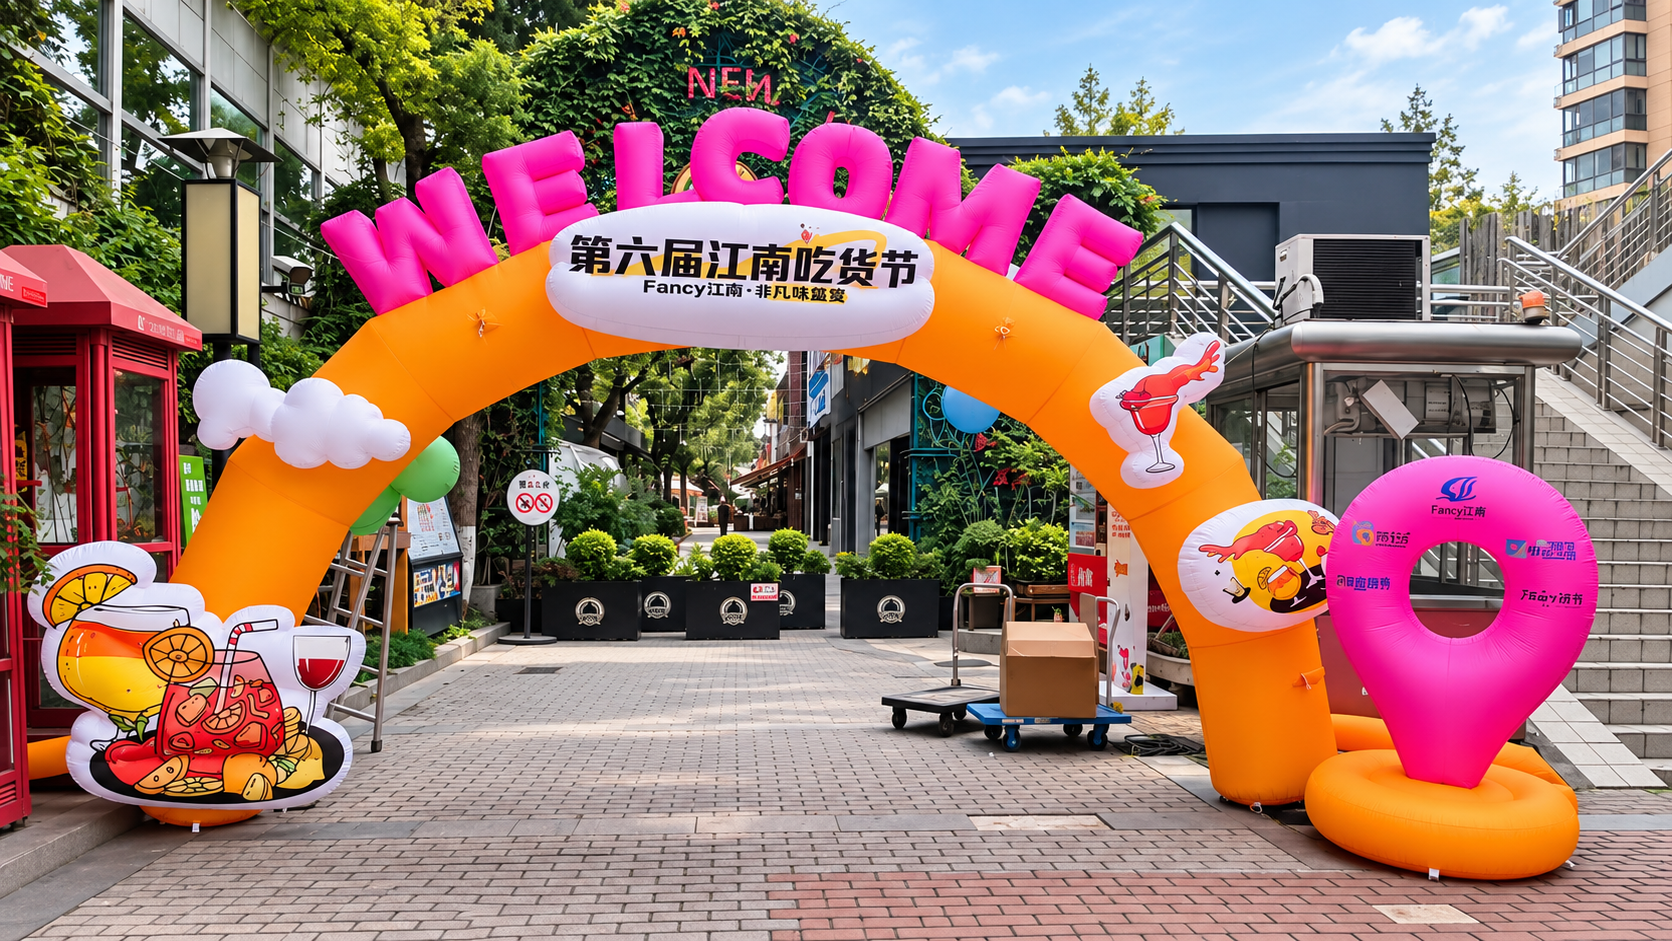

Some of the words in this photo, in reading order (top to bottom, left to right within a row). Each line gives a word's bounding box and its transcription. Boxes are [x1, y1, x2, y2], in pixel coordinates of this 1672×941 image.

[321, 108, 1142, 319] WELCOME
[570, 234, 918, 288] 第六届江南吃货节
